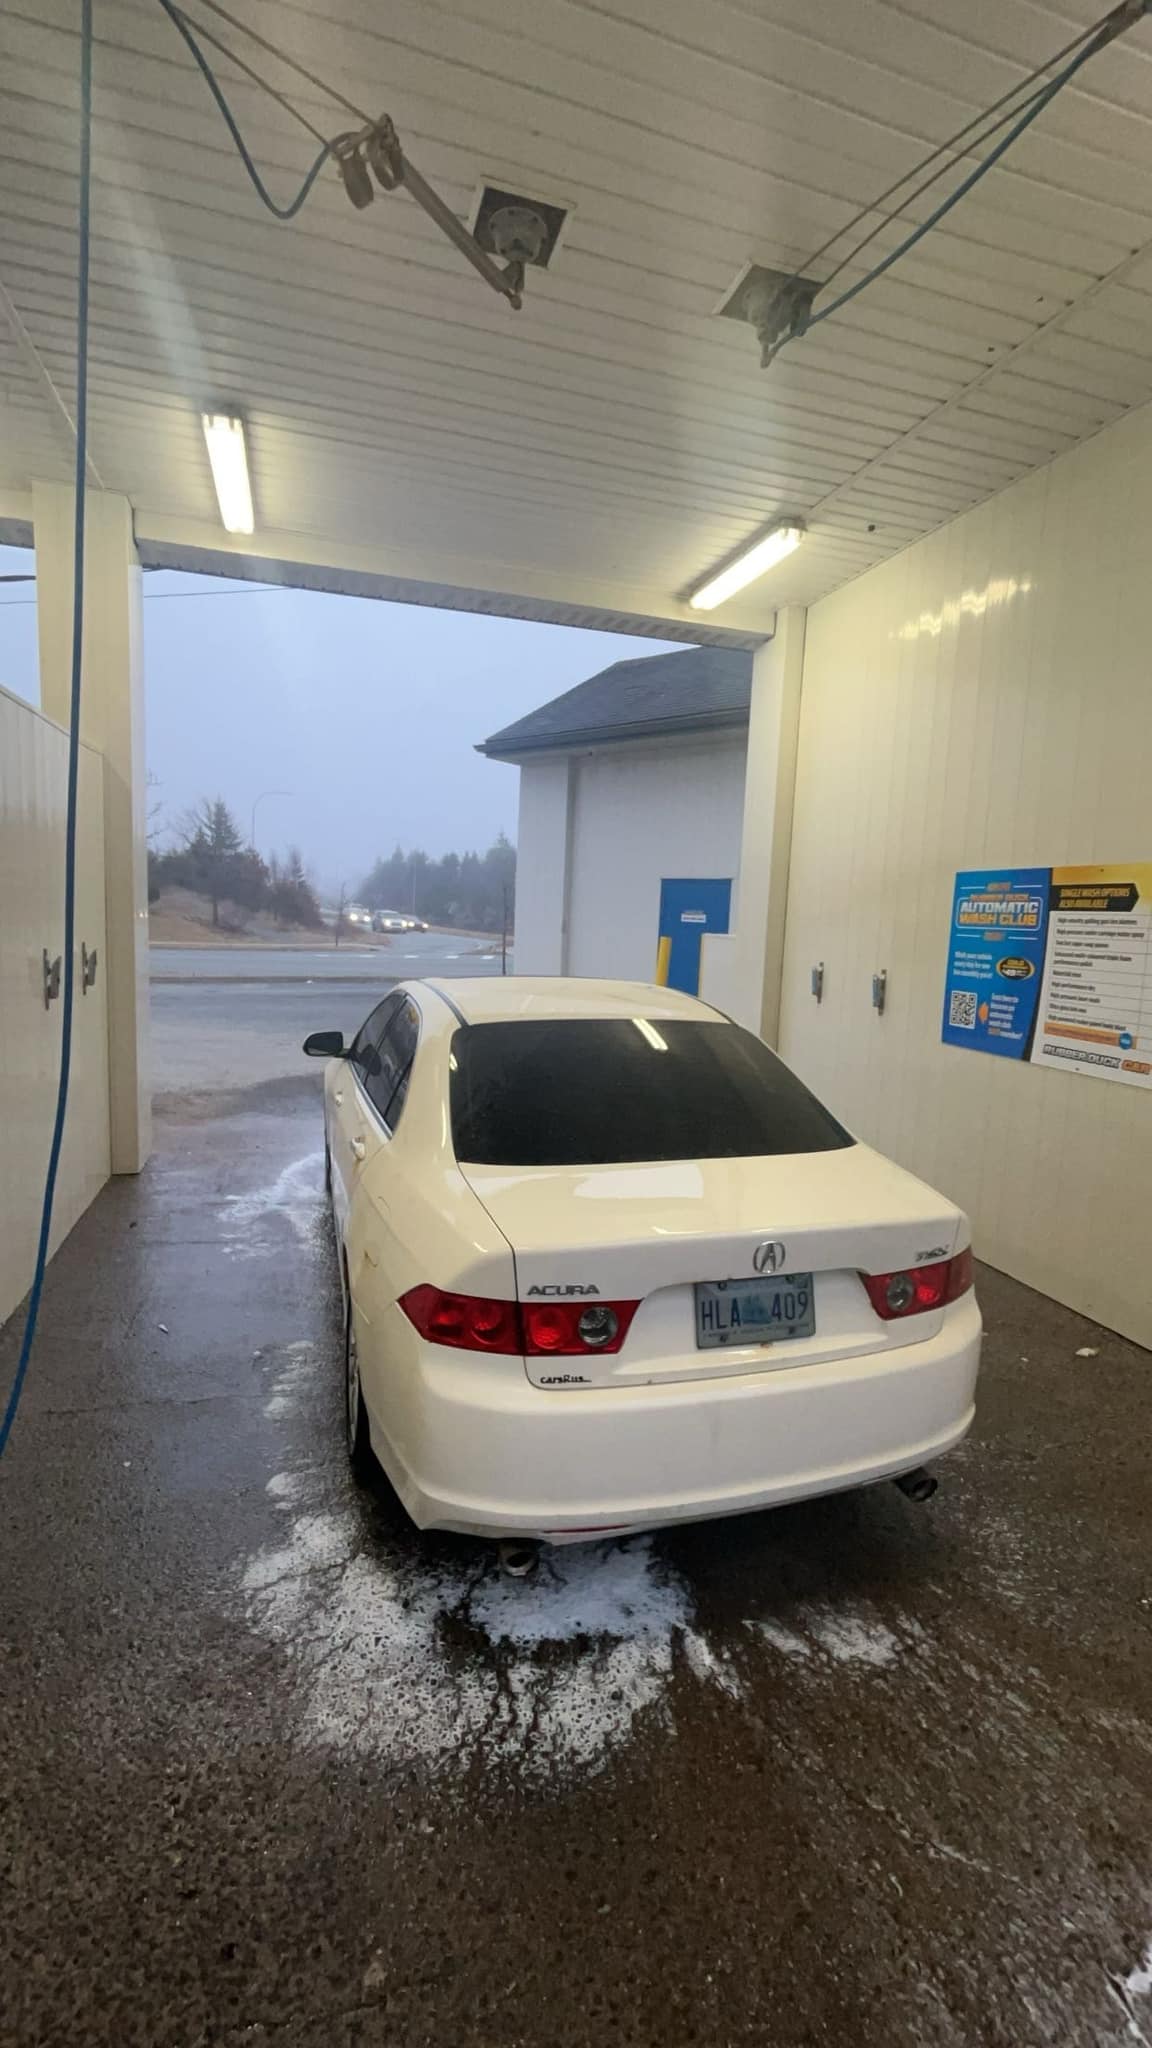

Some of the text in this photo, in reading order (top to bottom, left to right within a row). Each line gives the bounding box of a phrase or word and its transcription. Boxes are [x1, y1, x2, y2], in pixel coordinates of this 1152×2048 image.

[960, 901, 1040, 913] AUTOMATIC
[959, 912, 1038, 926] WASH CLUB
[1042, 1044, 1151, 1075] RUBBER DUCK CAR
[527, 1284, 600, 1296] ACURA
[701, 1298, 741, 1331] HLA
[772, 1290, 809, 1322] 409
